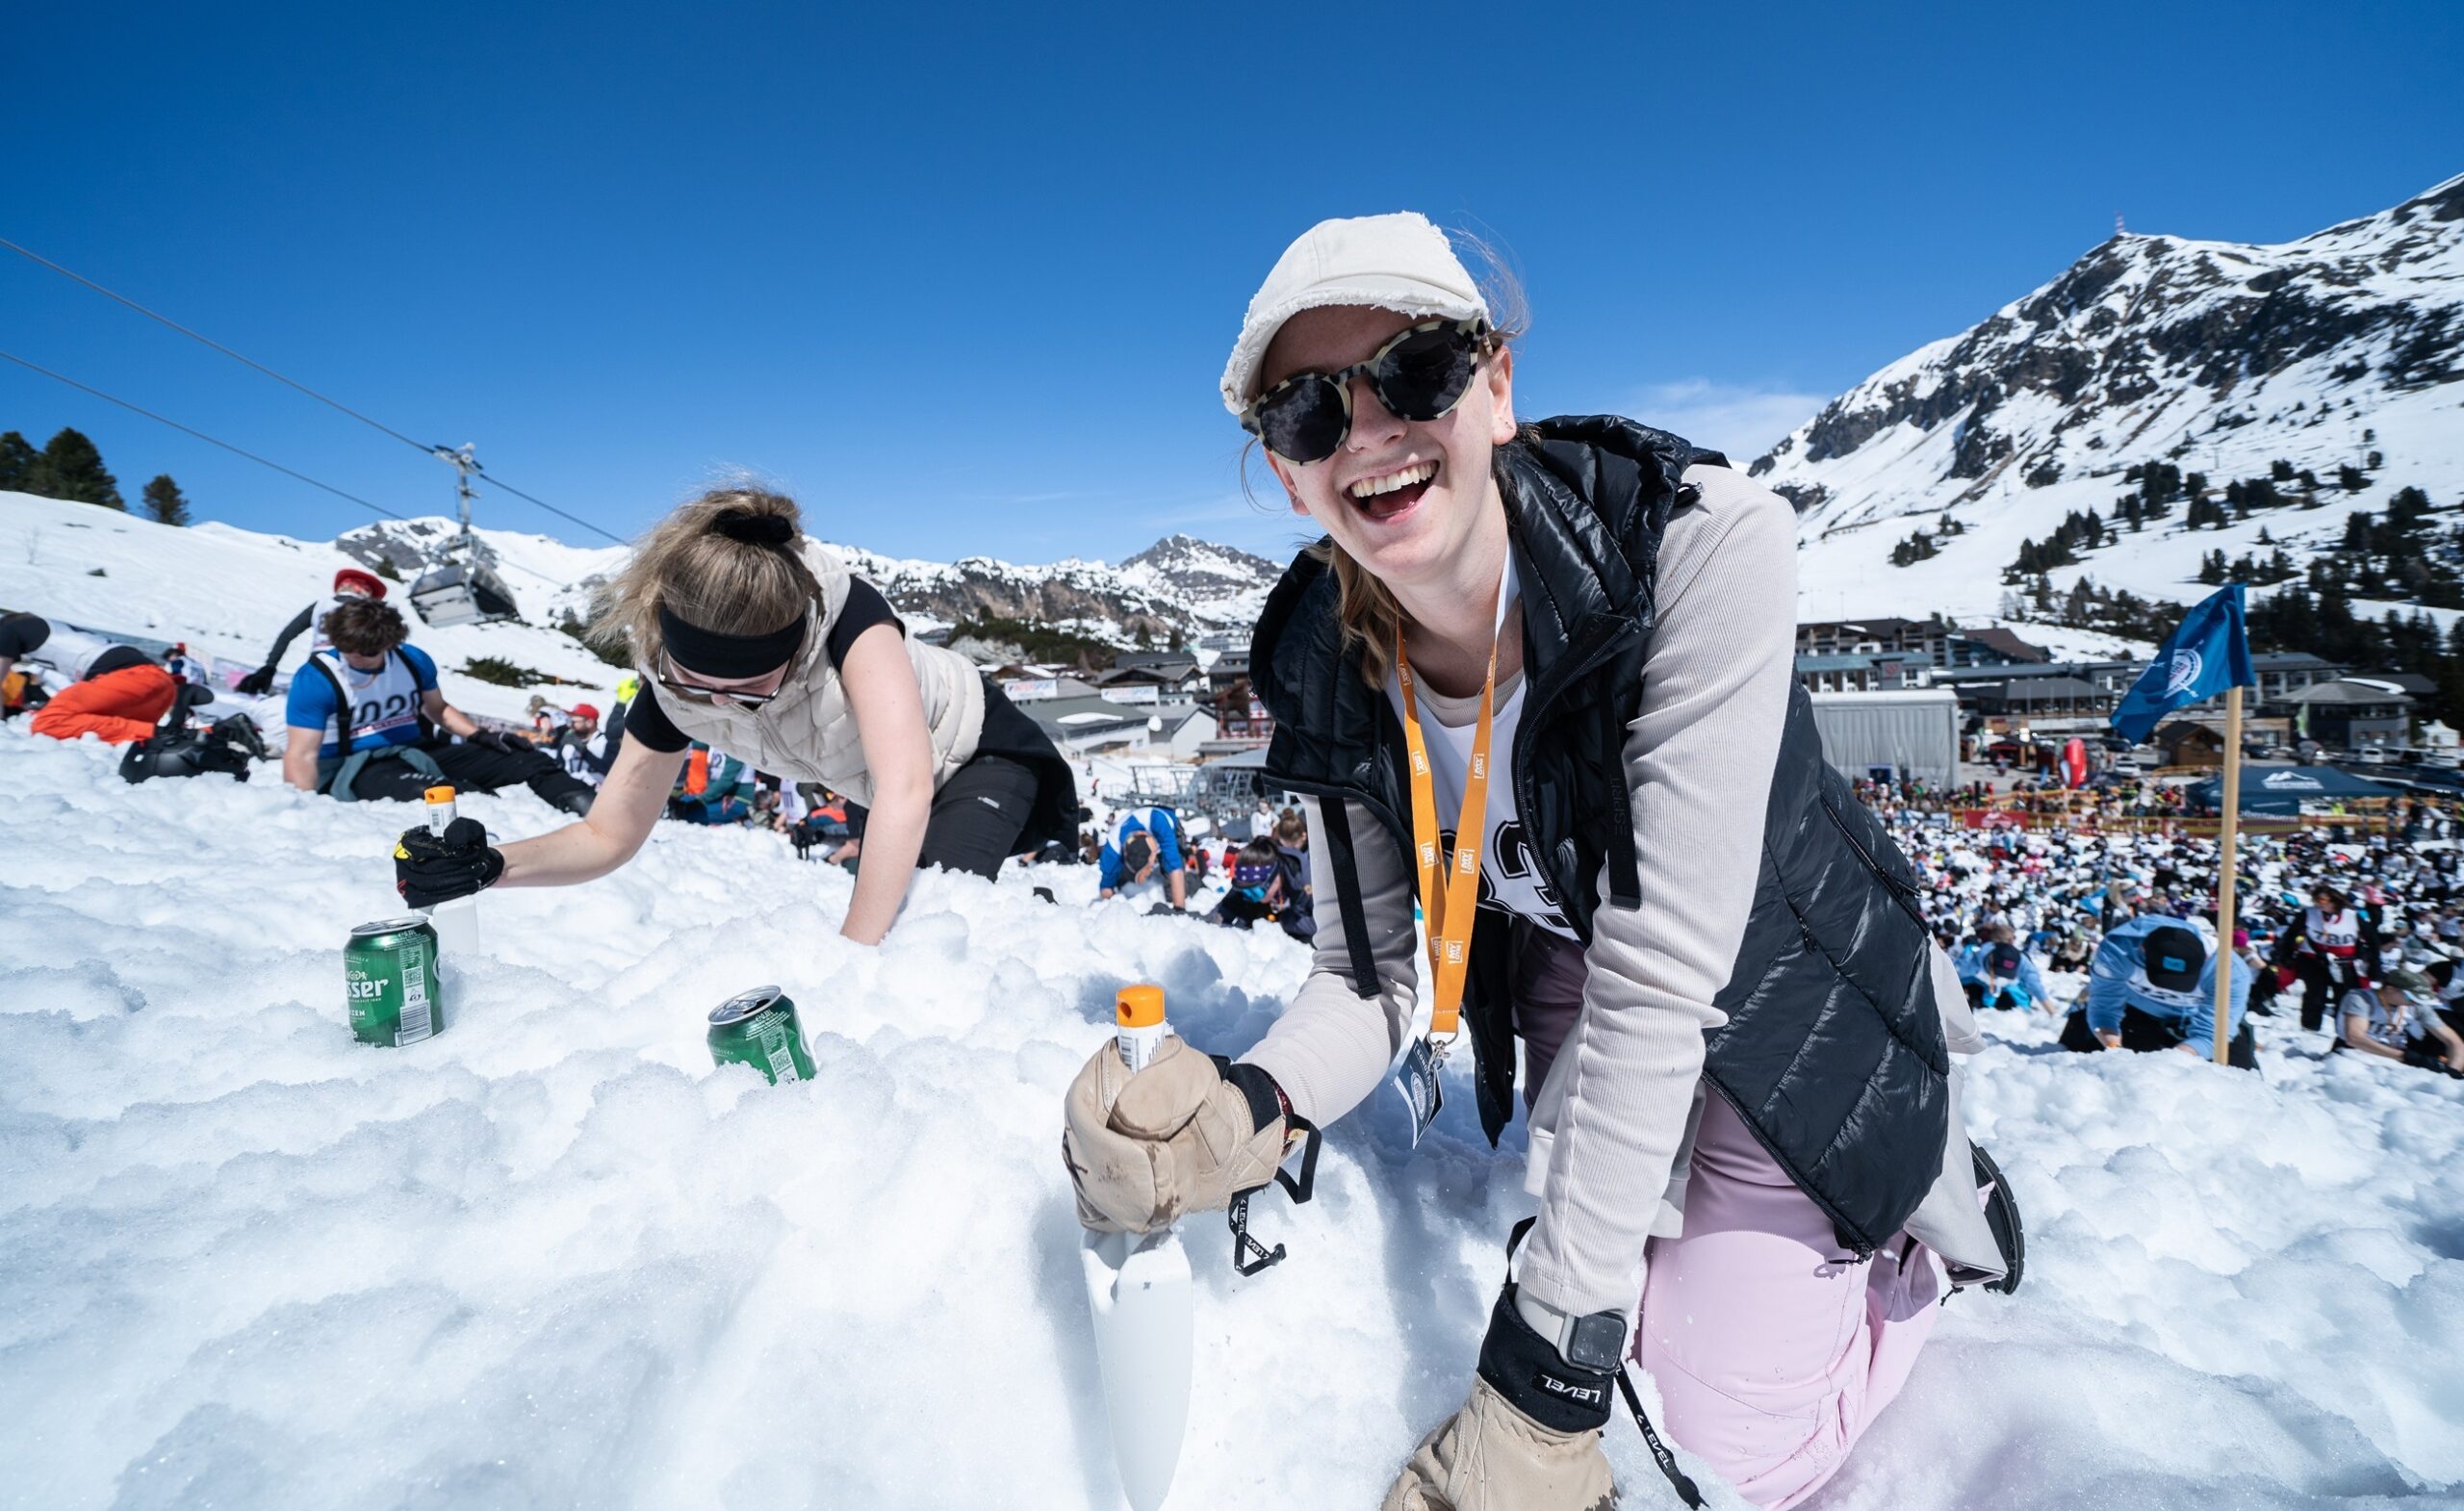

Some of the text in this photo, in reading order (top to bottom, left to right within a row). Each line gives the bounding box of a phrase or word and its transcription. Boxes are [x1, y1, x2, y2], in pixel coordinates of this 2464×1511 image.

[1238, 1207, 1246, 1237] LEVEL
[1541, 1373, 1602, 1404] LEVEL
[1644, 1425, 1670, 1469] LEVEL
